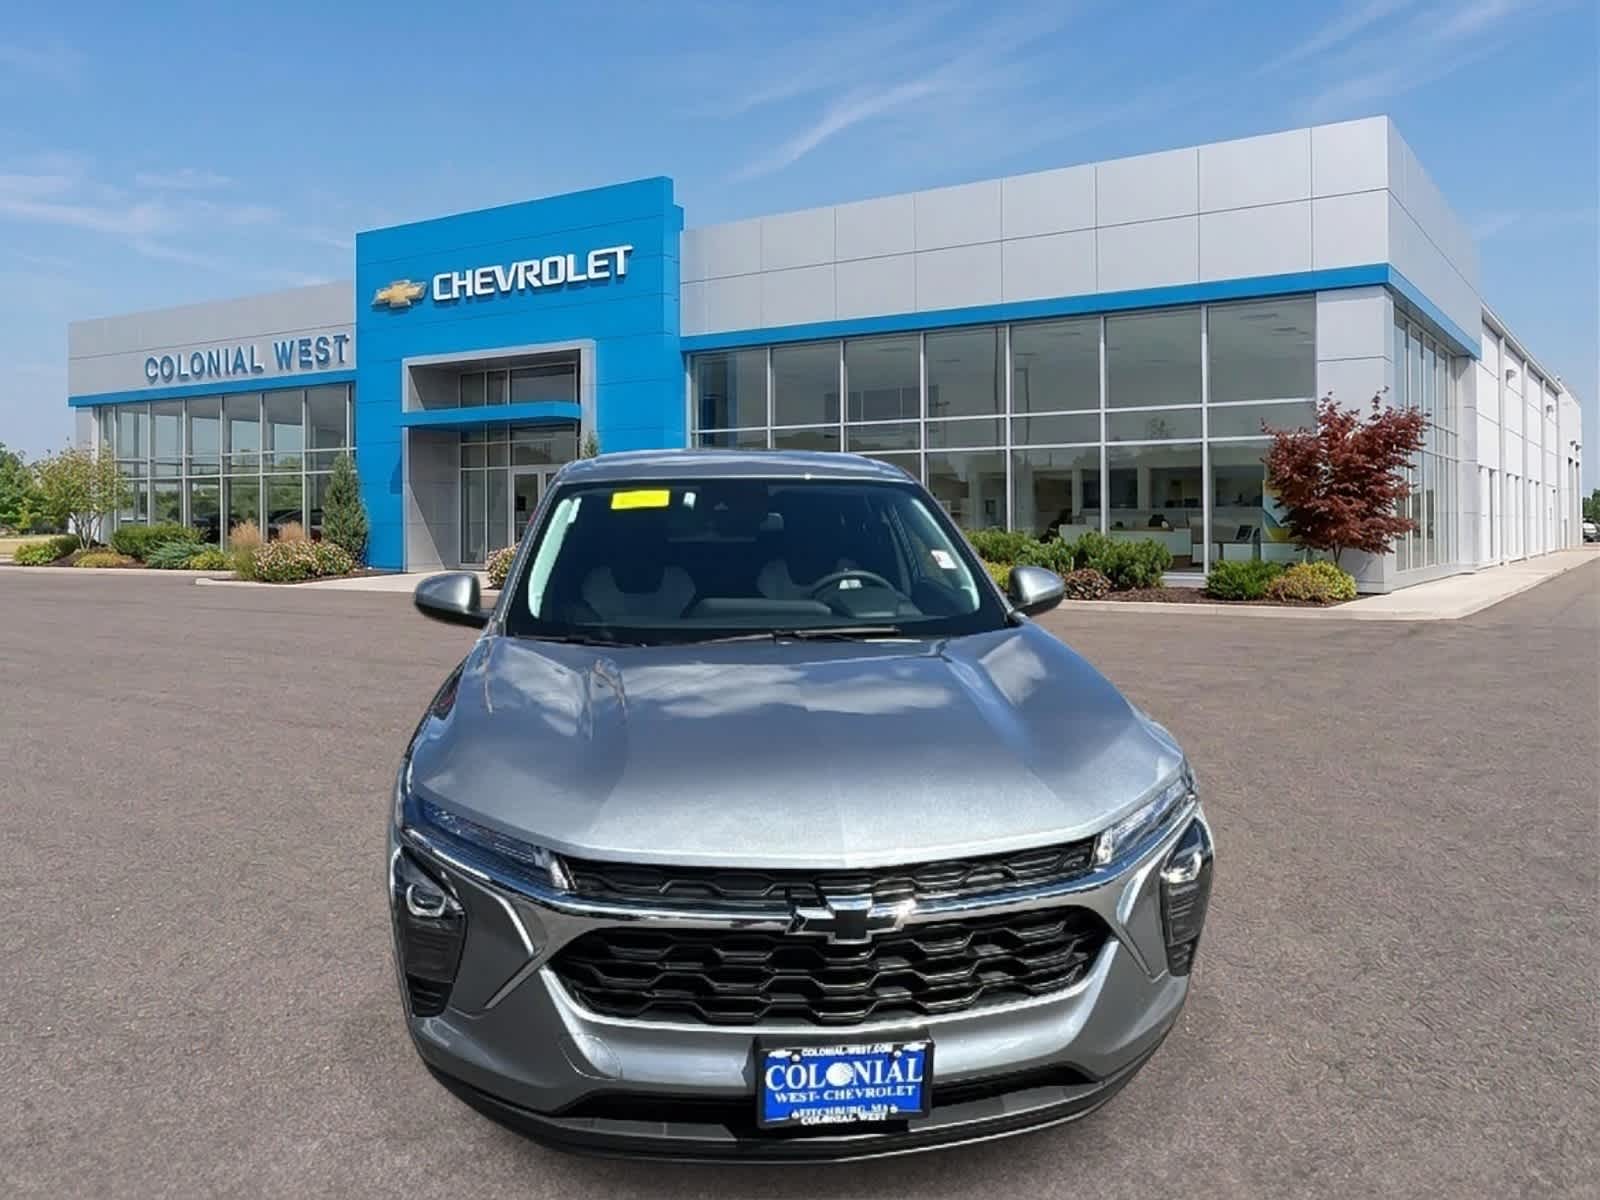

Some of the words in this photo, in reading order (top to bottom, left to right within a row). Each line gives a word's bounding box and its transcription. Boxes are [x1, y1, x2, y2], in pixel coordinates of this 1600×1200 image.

[432, 244, 634, 301] CHEVROLET
[144, 345, 264, 384] COLONIAL
[274, 333, 350, 370] WEST
[765, 1057, 923, 1091] COLONIAL
[823, 1085, 916, 1101] CHEVROLET
